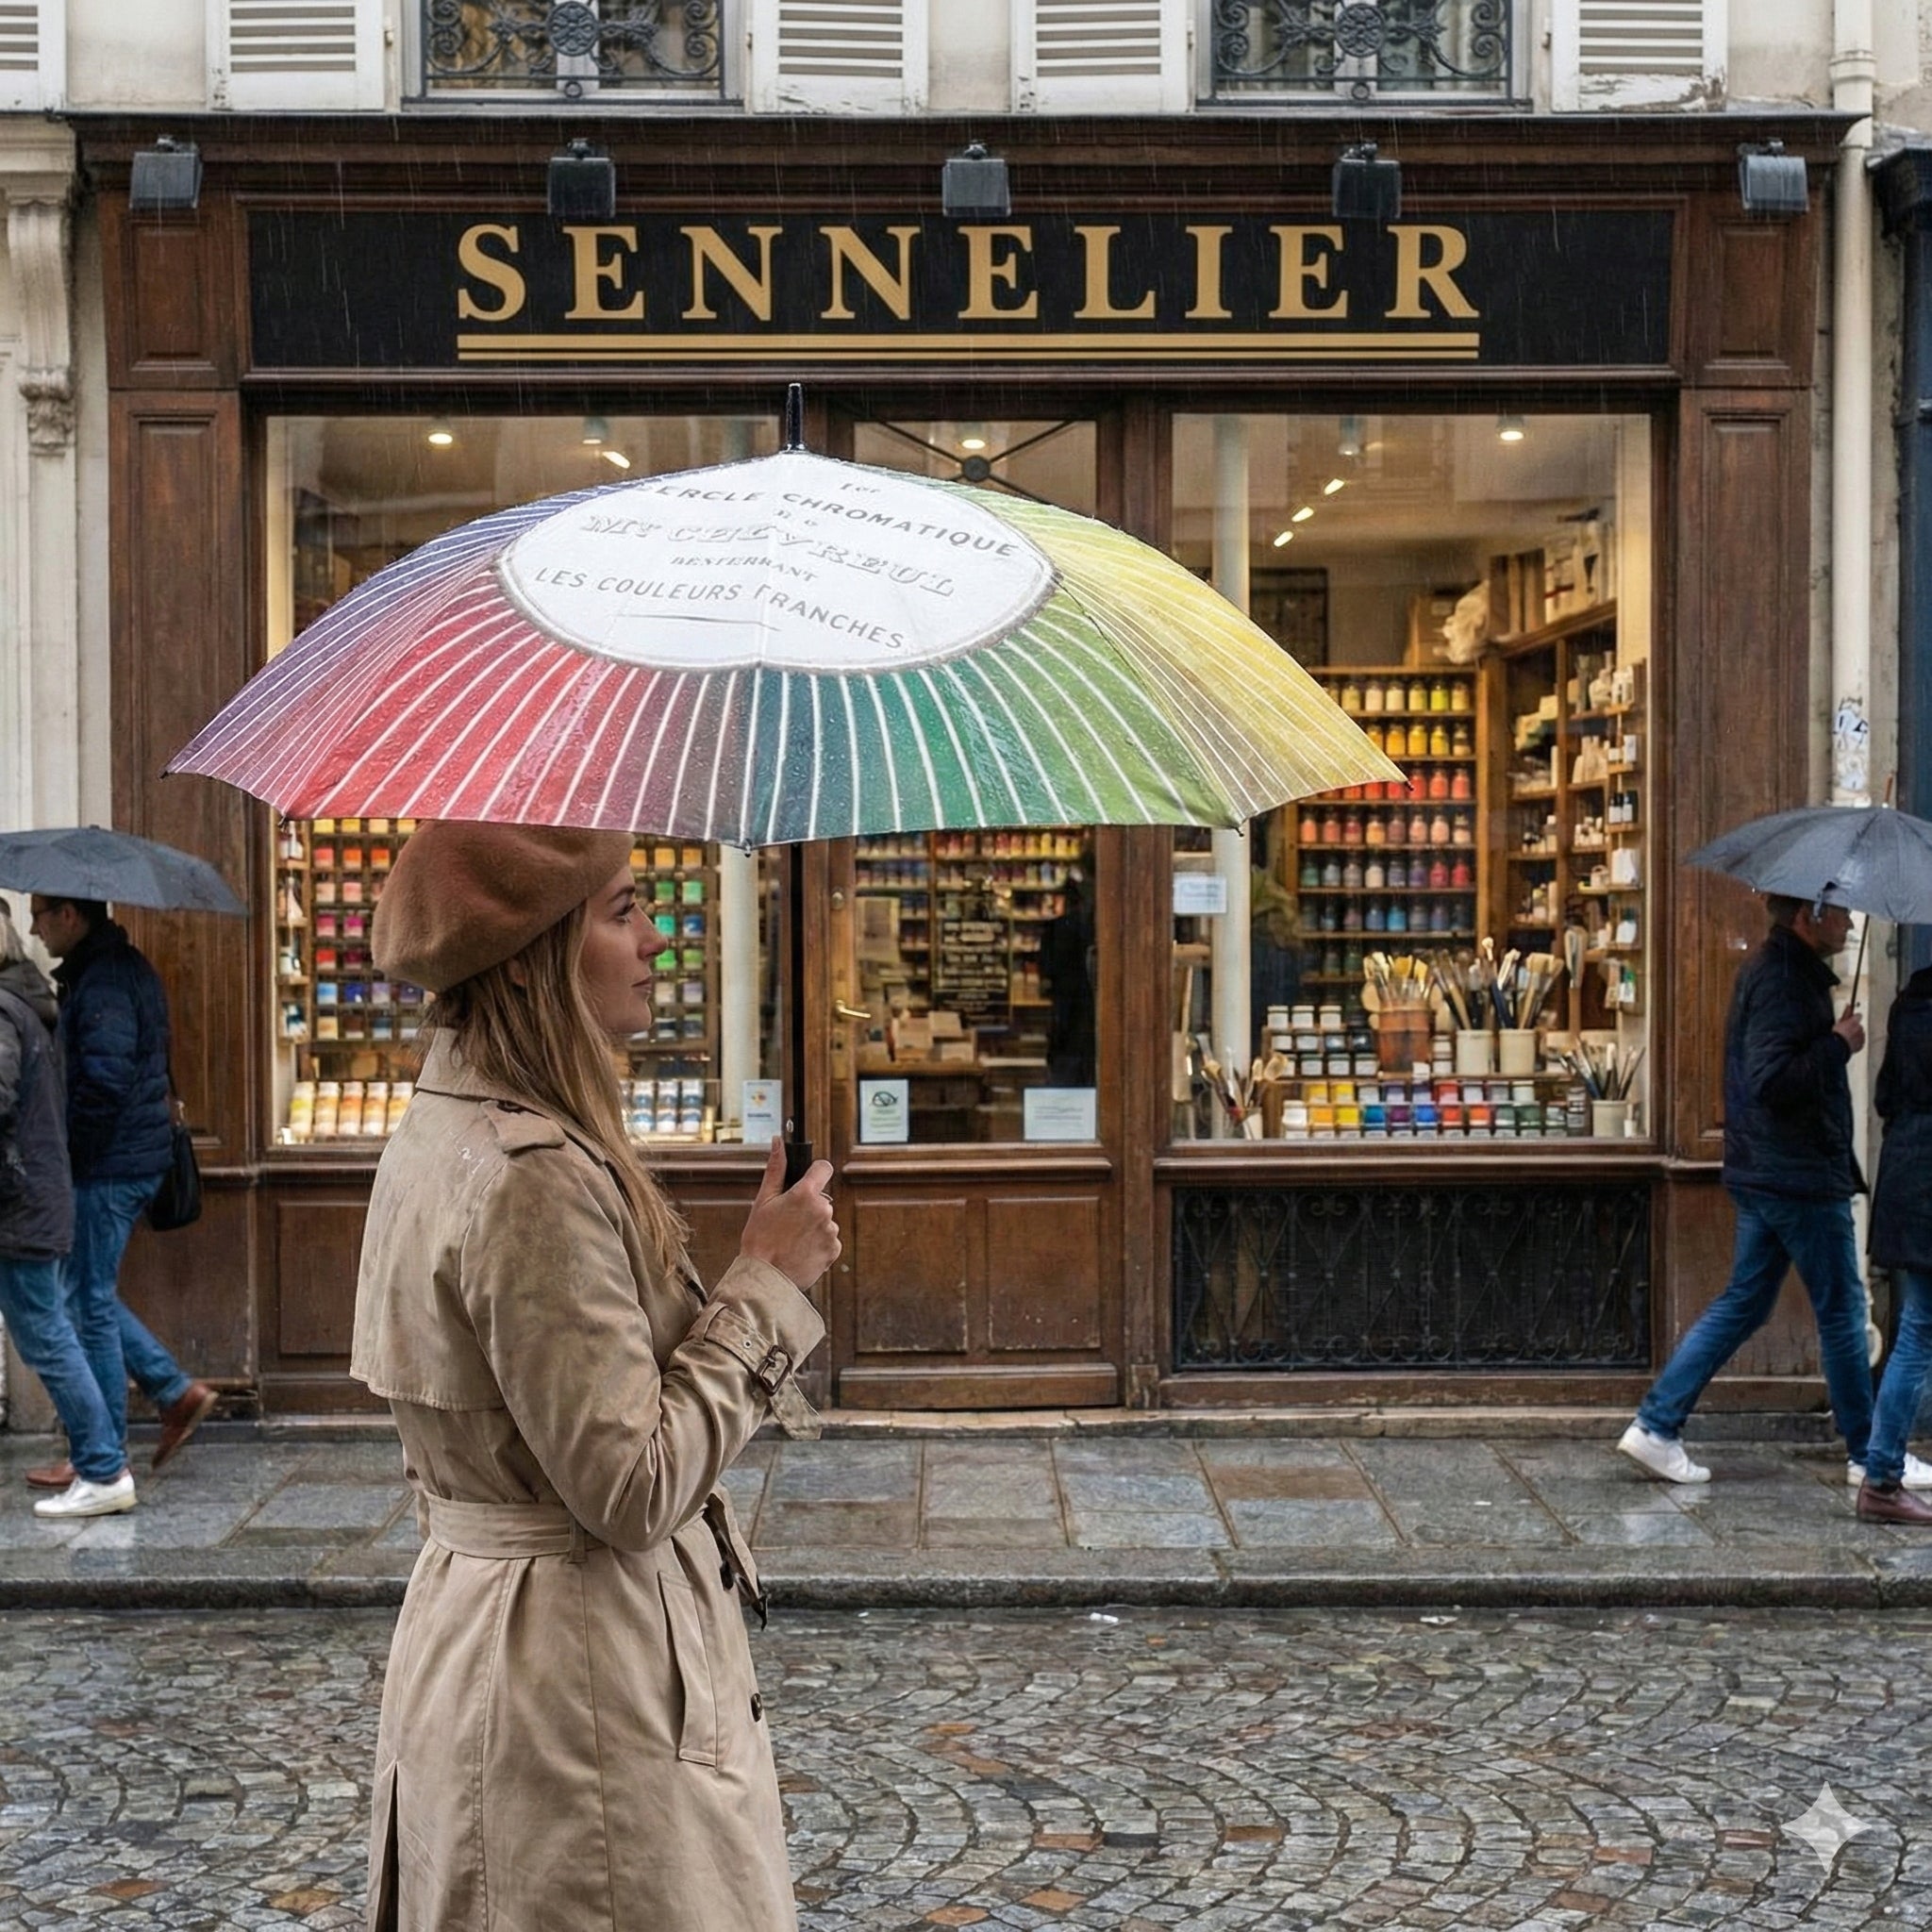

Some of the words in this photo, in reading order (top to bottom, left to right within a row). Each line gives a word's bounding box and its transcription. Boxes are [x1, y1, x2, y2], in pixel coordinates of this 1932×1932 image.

[457, 223, 1480, 322] SENNELIER
[637, 481, 766, 502] ERCLE
[781, 491, 1022, 558] CHROMATIQUE
[535, 567, 588, 589] LES
[597, 575, 743, 601] COULEURS
